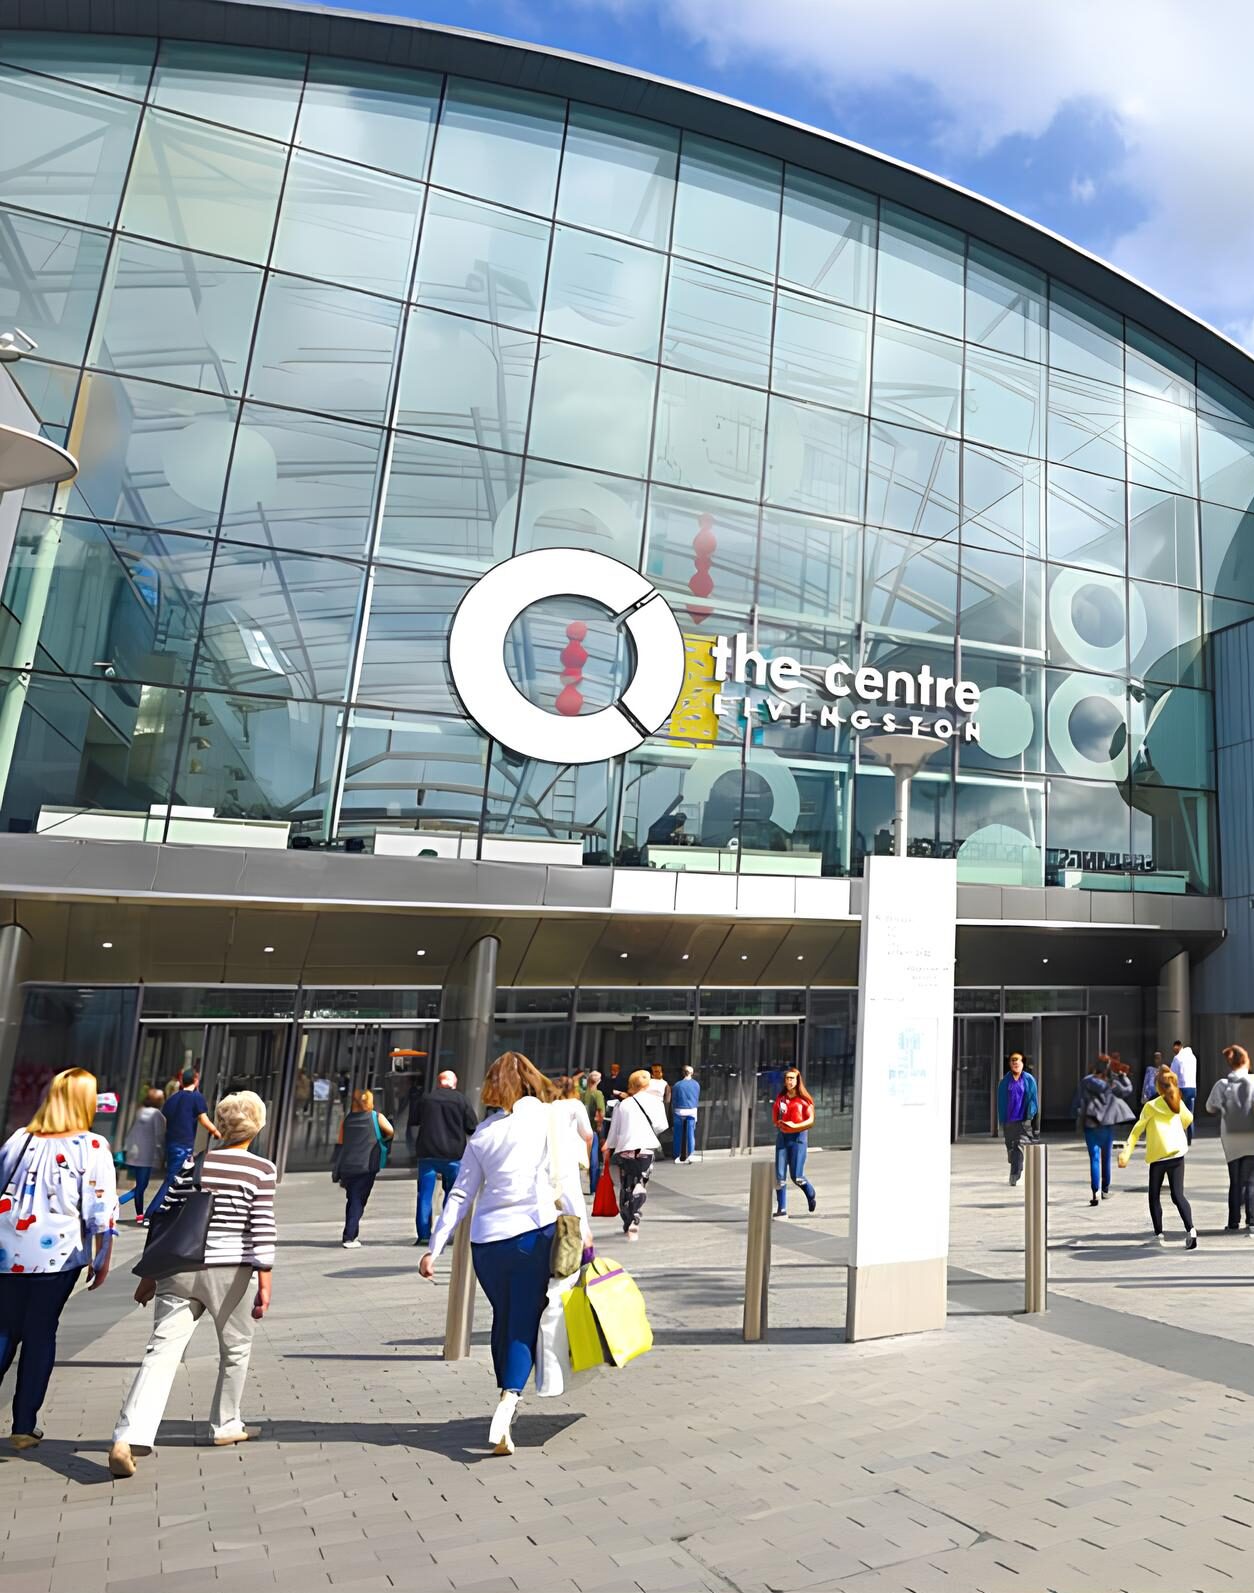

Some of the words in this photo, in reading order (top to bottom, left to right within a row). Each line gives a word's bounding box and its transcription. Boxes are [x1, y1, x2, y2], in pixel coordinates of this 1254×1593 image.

[711, 633, 801, 690] the
[824, 664, 981, 714] centre
[713, 694, 981, 742] LIVINGSTON
